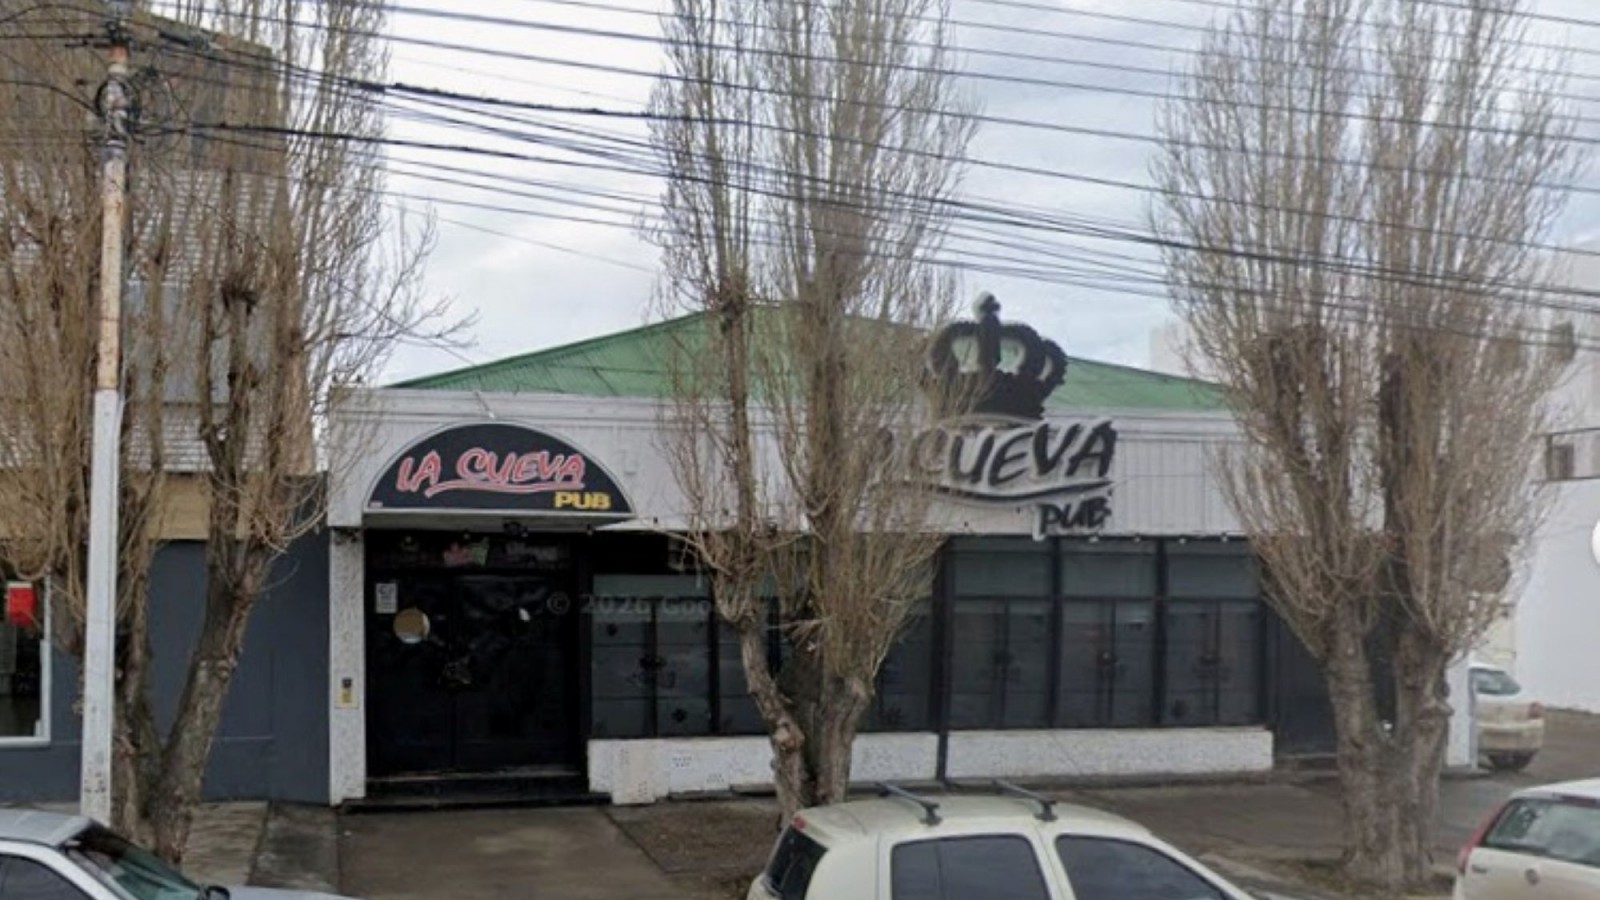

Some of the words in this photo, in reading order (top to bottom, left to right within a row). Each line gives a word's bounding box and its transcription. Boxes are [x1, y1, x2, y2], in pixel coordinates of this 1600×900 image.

[396, 449, 441, 493] LA
[456, 446, 586, 483] CUEVA
[908, 419, 1118, 487] CUEVA
[554, 491, 611, 510] PUB
